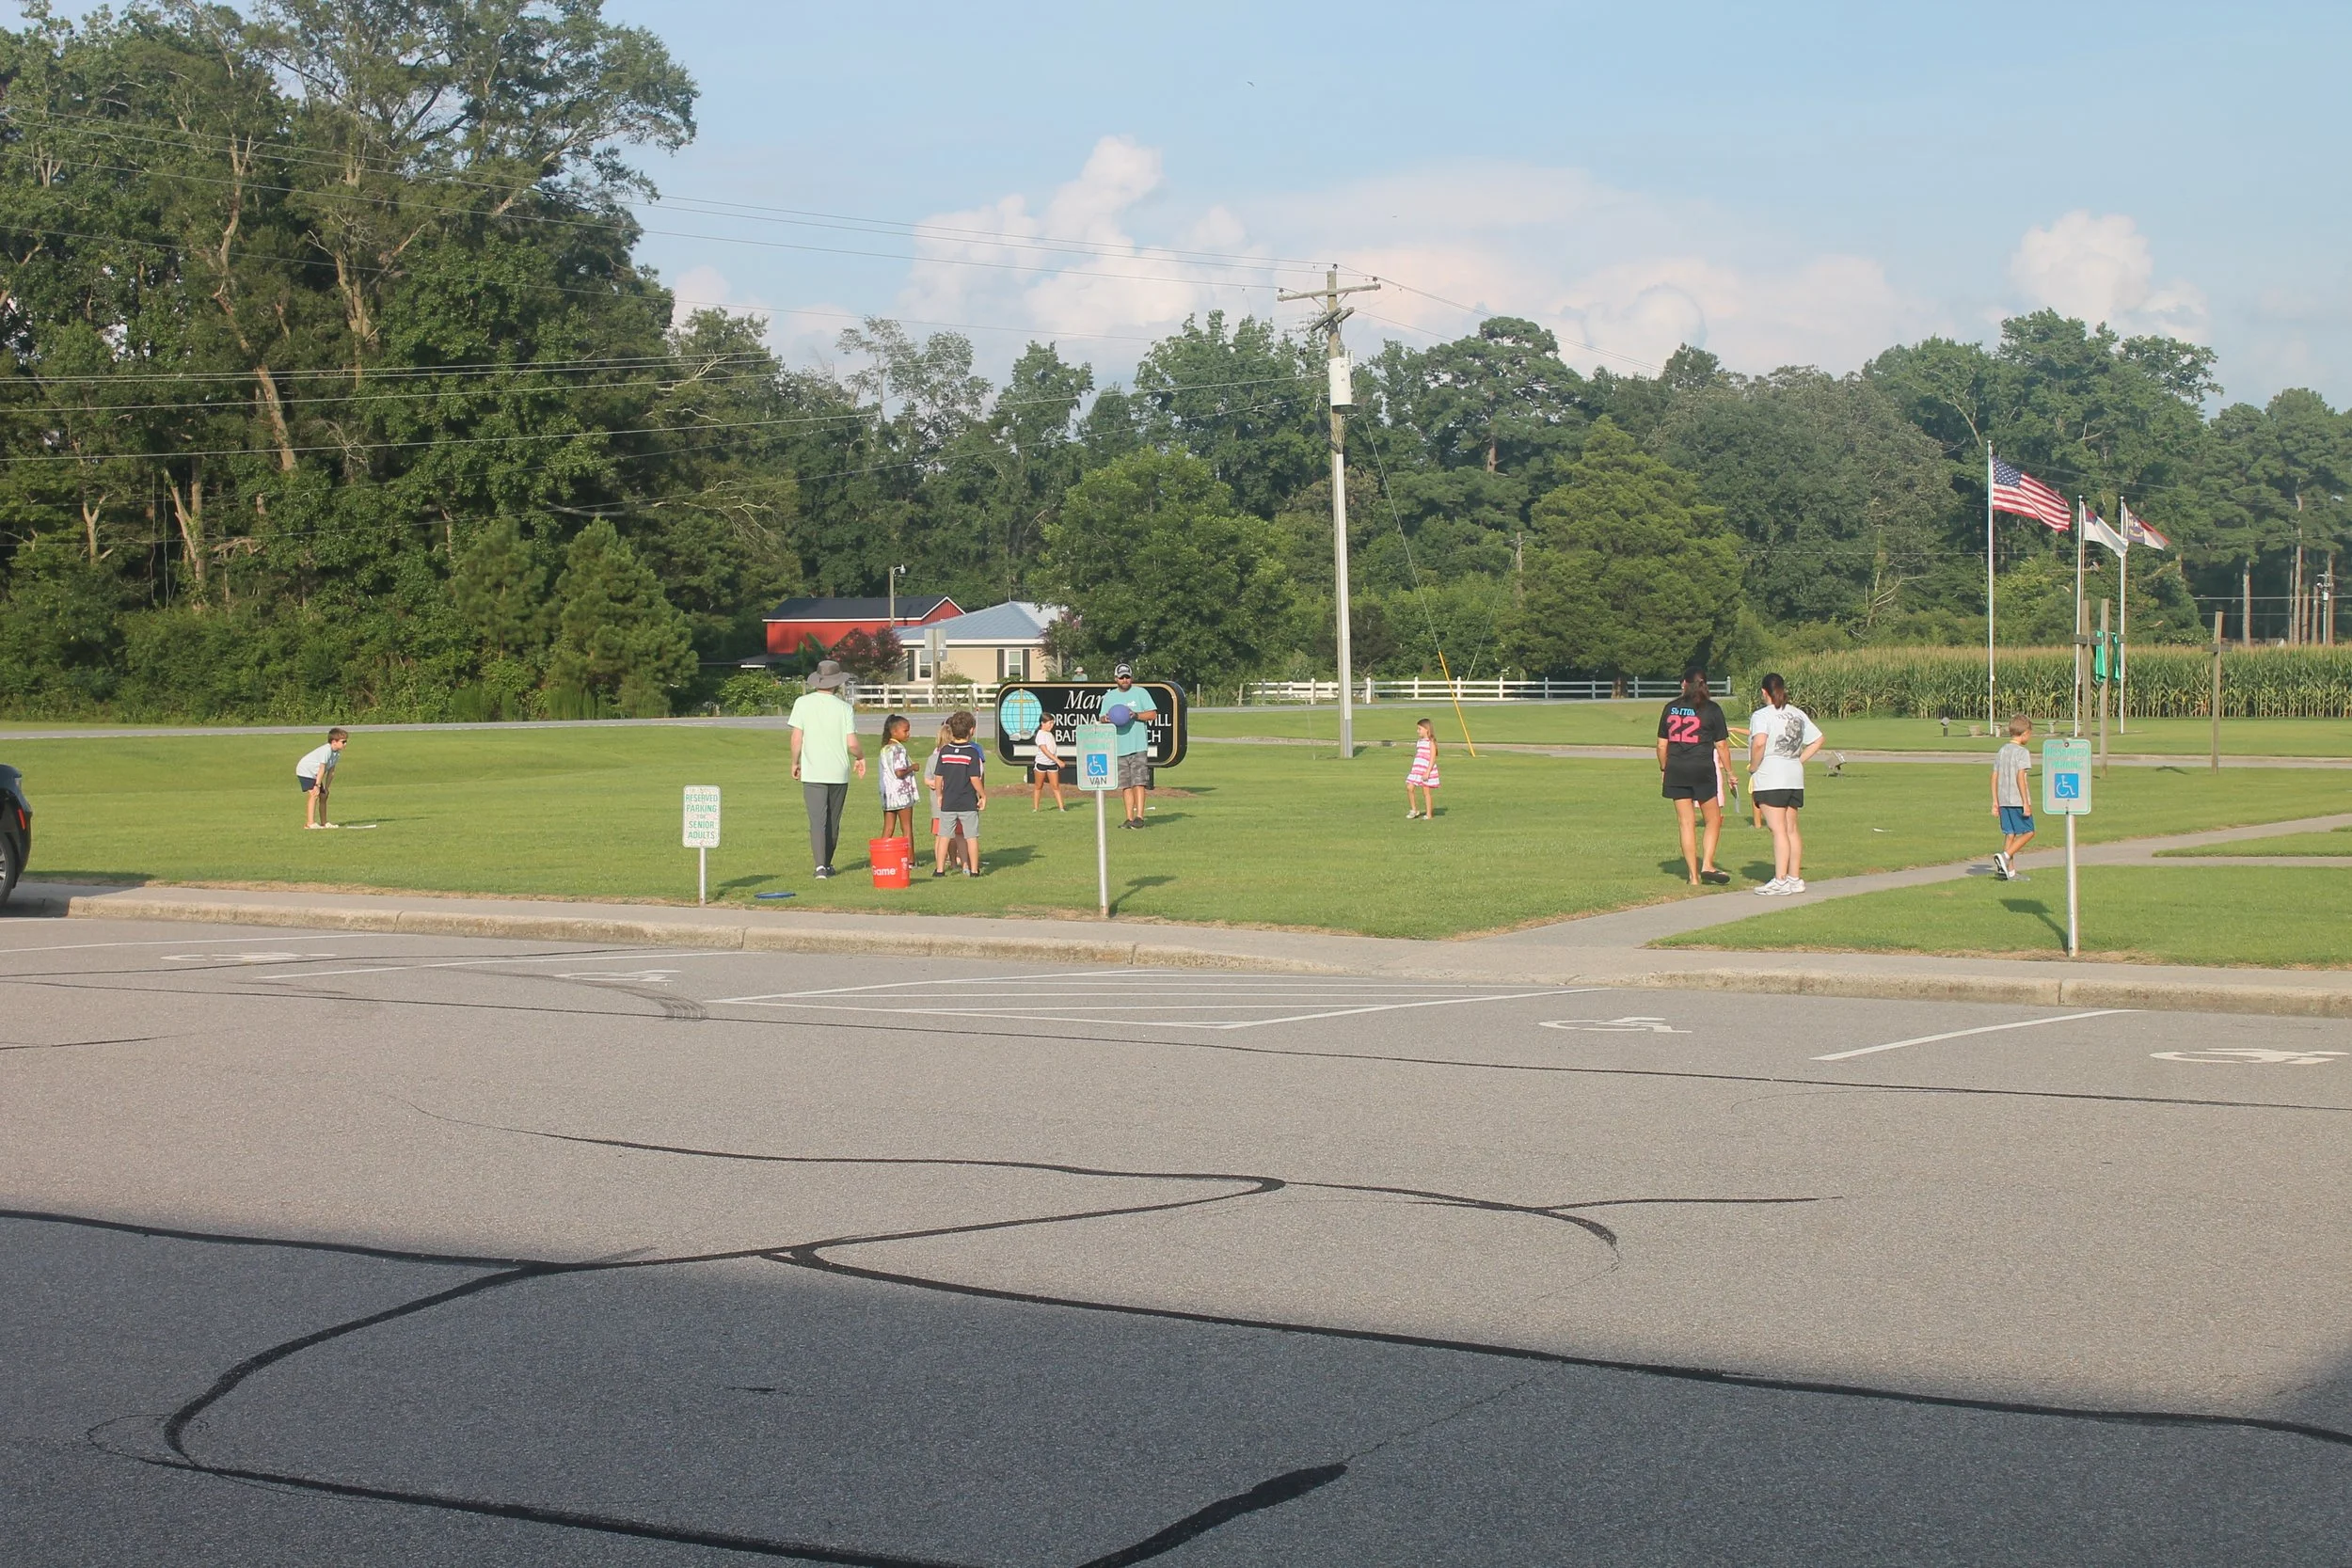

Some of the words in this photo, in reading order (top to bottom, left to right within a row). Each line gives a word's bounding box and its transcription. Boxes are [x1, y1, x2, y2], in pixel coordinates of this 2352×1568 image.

[1064, 689, 1105, 709] Mar
[1051, 713, 1097, 726] RIGINA
[1666, 715, 1701, 744] 22
[1089, 777, 1107, 785] VAN
[685, 794, 718, 802] RESERVED
[686, 804, 717, 813] PARKING
[688, 820, 715, 829] SENIOR
[688, 831, 715, 839] ADULTS
